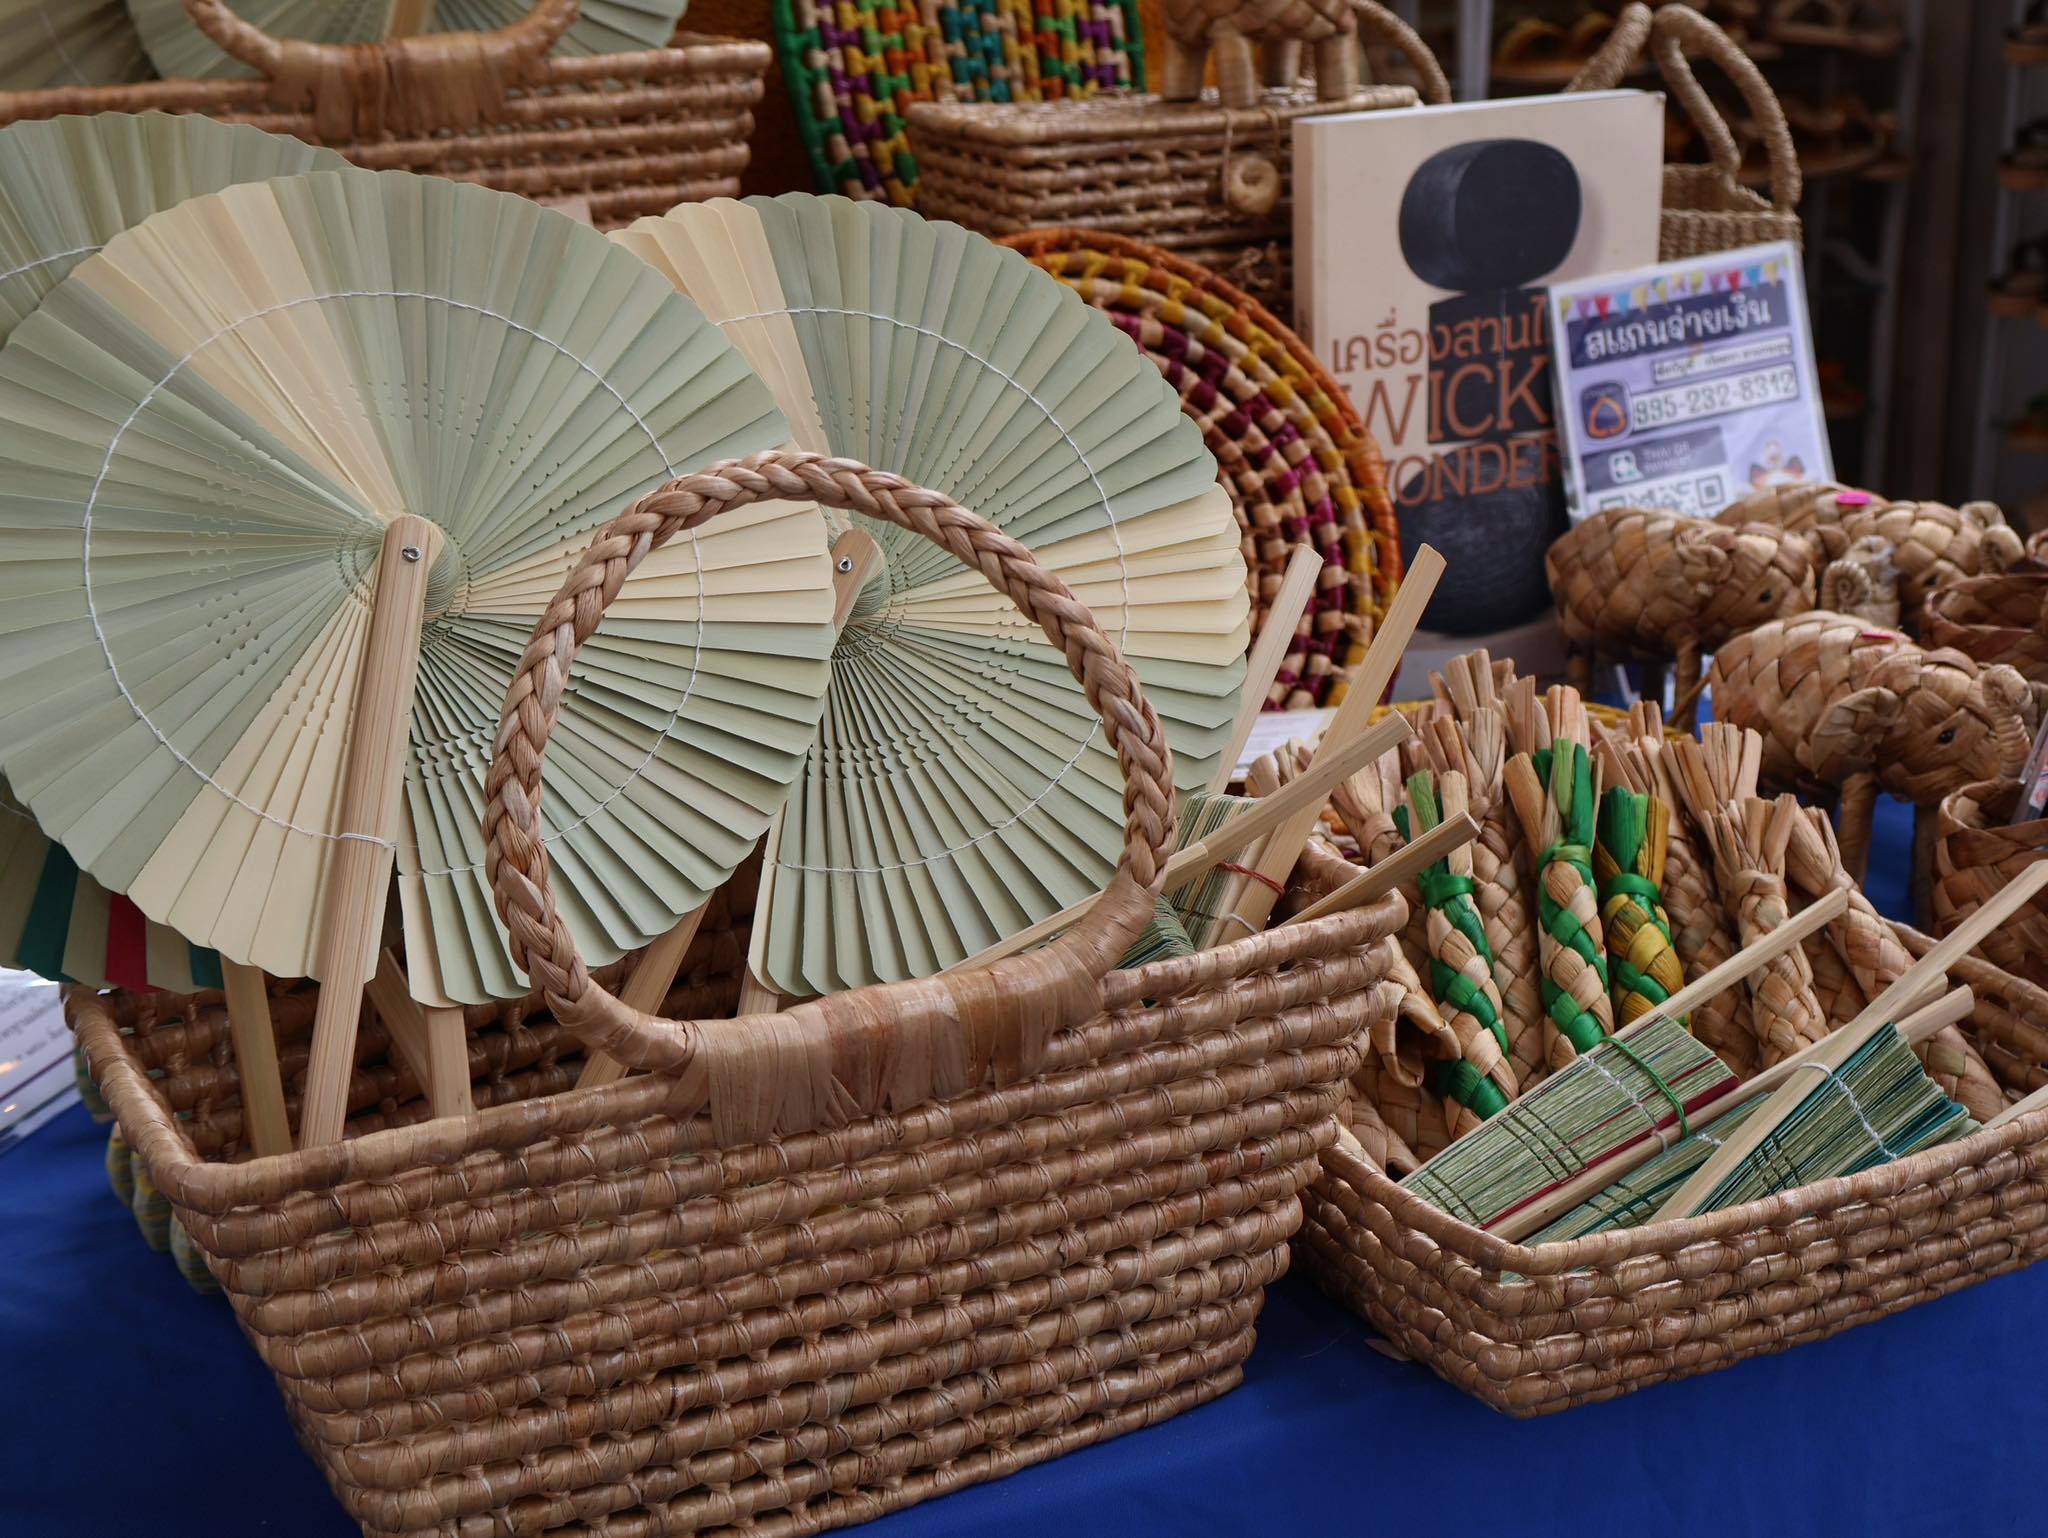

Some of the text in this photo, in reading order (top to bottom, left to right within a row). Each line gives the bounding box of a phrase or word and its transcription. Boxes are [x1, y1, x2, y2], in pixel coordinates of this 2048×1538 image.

[1332, 295, 1550, 374] เครื่องสานไ
[1584, 293, 1772, 360] สแกนจ่ายเงิน
